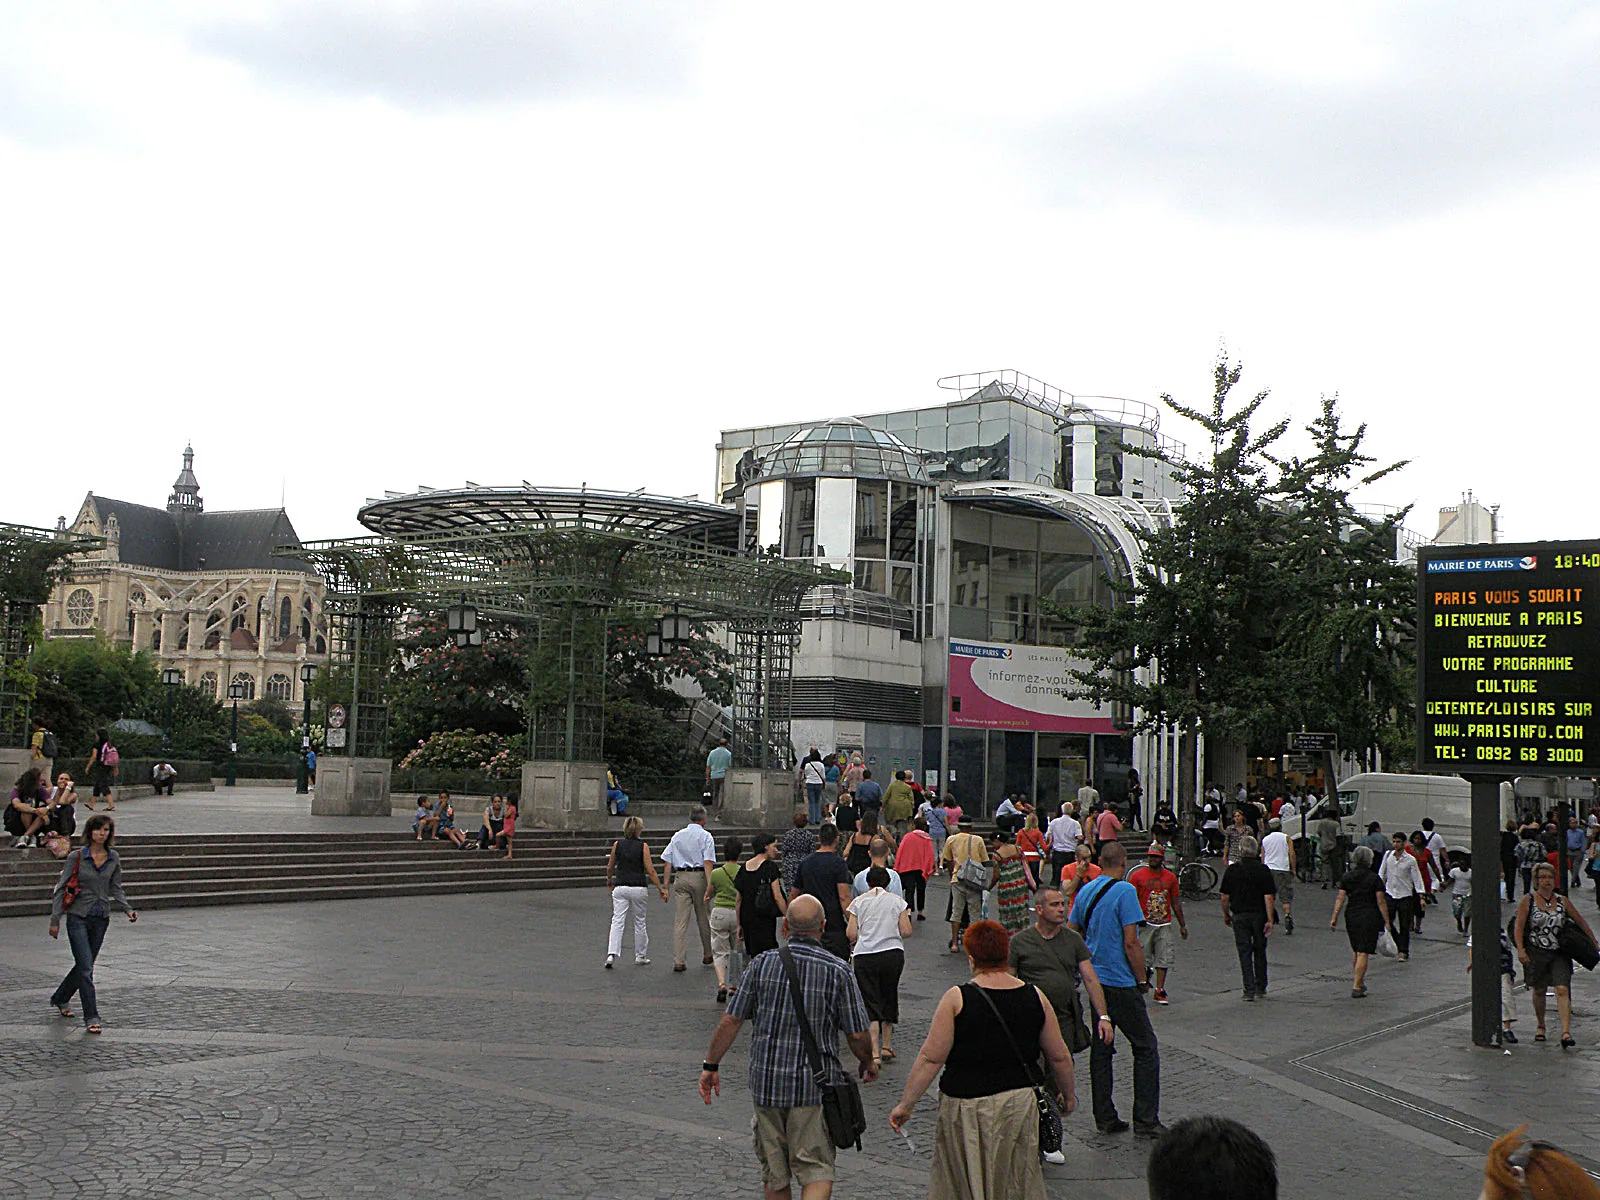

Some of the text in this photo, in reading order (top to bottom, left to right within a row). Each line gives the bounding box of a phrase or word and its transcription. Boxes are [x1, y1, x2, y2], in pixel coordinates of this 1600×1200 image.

[1428, 559, 1514, 571] MAIRIE DE PARIS
[1555, 553, 1600, 569] 18:40
[1434, 588, 1583, 606] PARIS VOUS SOURIT
[1434, 611, 1583, 627] BIENVENUE A PARIS
[1467, 634, 1547, 649] RETROUVEZ
[955, 645, 973, 655] MAIRIE
[982, 649, 999, 657] PARIS
[1442, 656, 1574, 671] VOTRE PROGRAMME
[1476, 679, 1537, 693] CULTURE
[1426, 701, 1593, 716] DETENTE/LOISIRS SUR
[1434, 723, 1583, 740] WWW.PARISINFO.COM
[1434, 745, 1584, 763] TEL: 0892 68 3000
